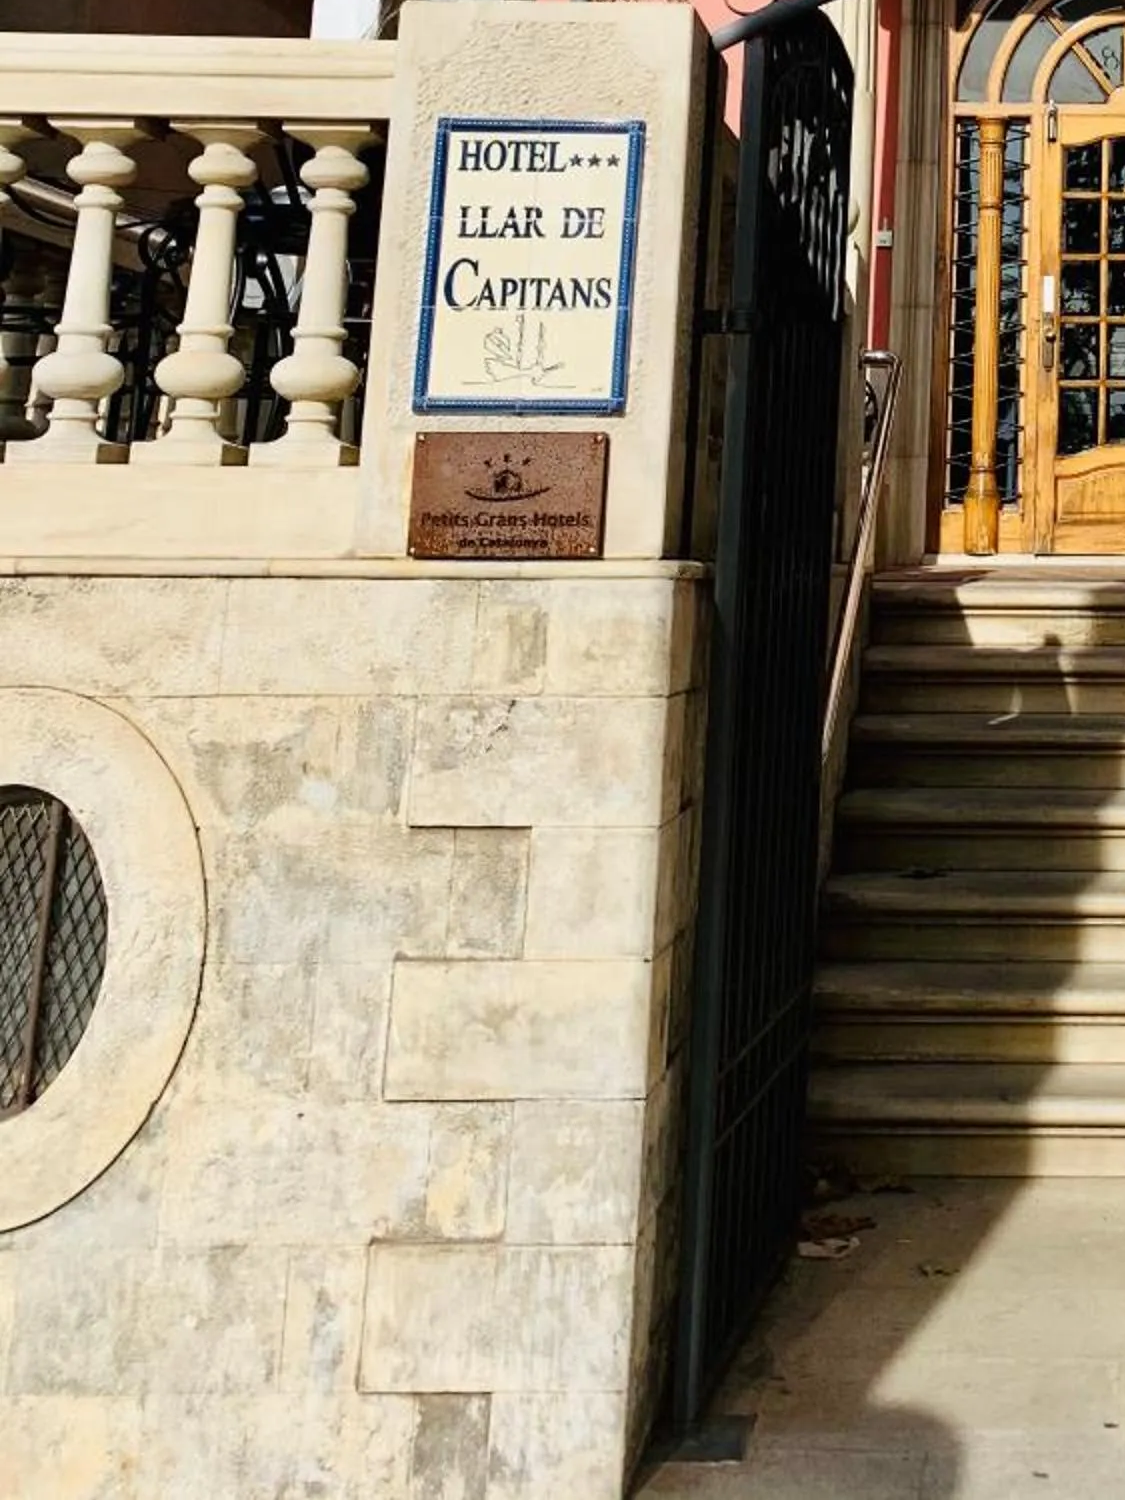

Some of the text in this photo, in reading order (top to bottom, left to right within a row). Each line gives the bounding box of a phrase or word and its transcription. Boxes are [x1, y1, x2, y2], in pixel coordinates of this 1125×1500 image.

[457, 139, 566, 174] HOTEL
[457, 205, 606, 239] LLAR DE
[443, 257, 612, 310] CAPITANS
[421, 511, 591, 528] Petits Grans Hotels
